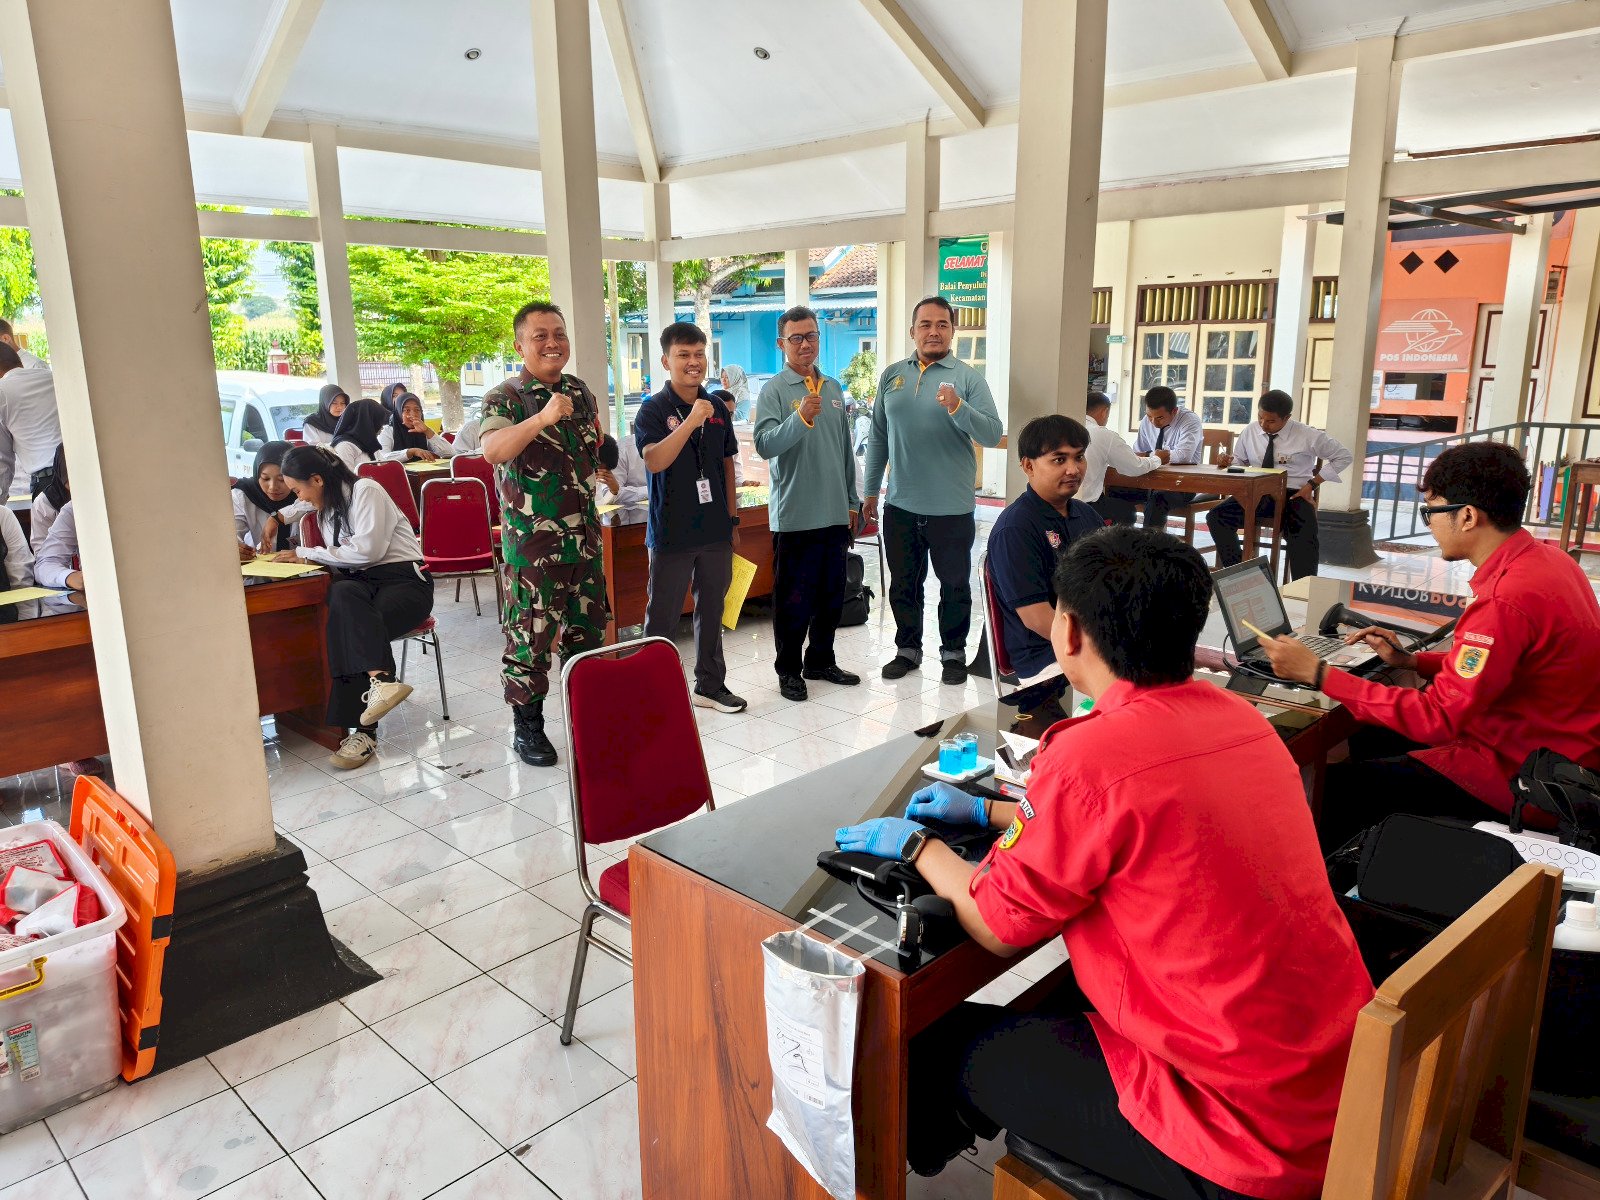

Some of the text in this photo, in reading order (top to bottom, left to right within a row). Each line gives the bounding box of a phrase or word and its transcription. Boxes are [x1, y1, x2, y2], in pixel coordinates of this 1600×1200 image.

[944, 255, 987, 269] SELAMAT
[940, 282, 956, 290] Balai
[950, 294, 986, 302] Kecamatan
[1380, 353, 1459, 362] POS INDONESIA
